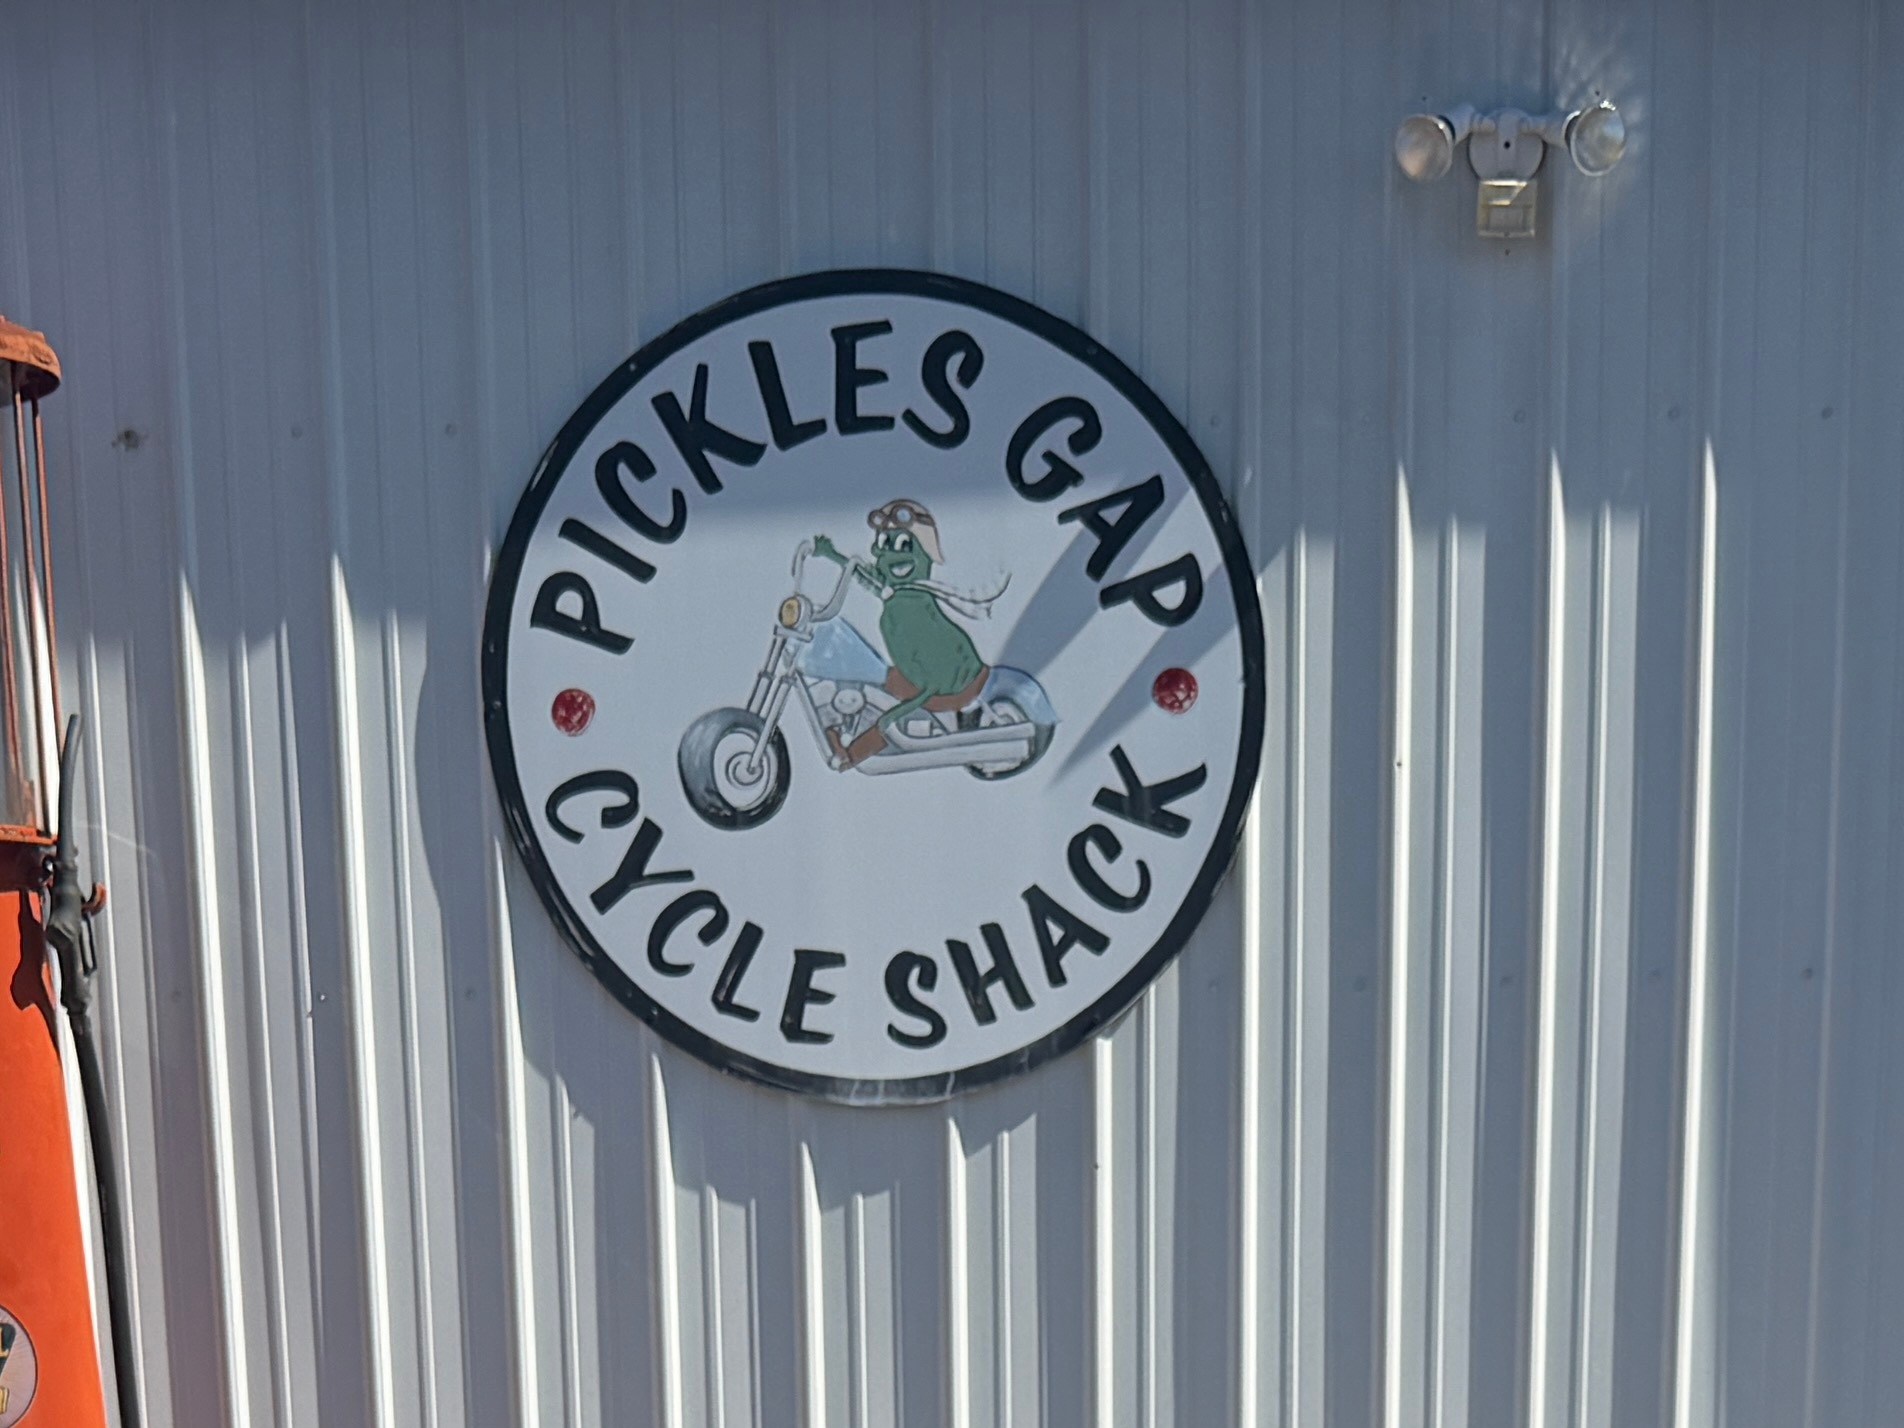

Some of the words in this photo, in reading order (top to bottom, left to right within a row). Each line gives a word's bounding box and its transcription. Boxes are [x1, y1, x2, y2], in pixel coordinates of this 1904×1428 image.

[530, 320, 984, 655] PICKLES
[1006, 397, 1203, 628] GAP
[545, 770, 846, 1044] CYCLE
[884, 745, 1207, 1048] SHACK
